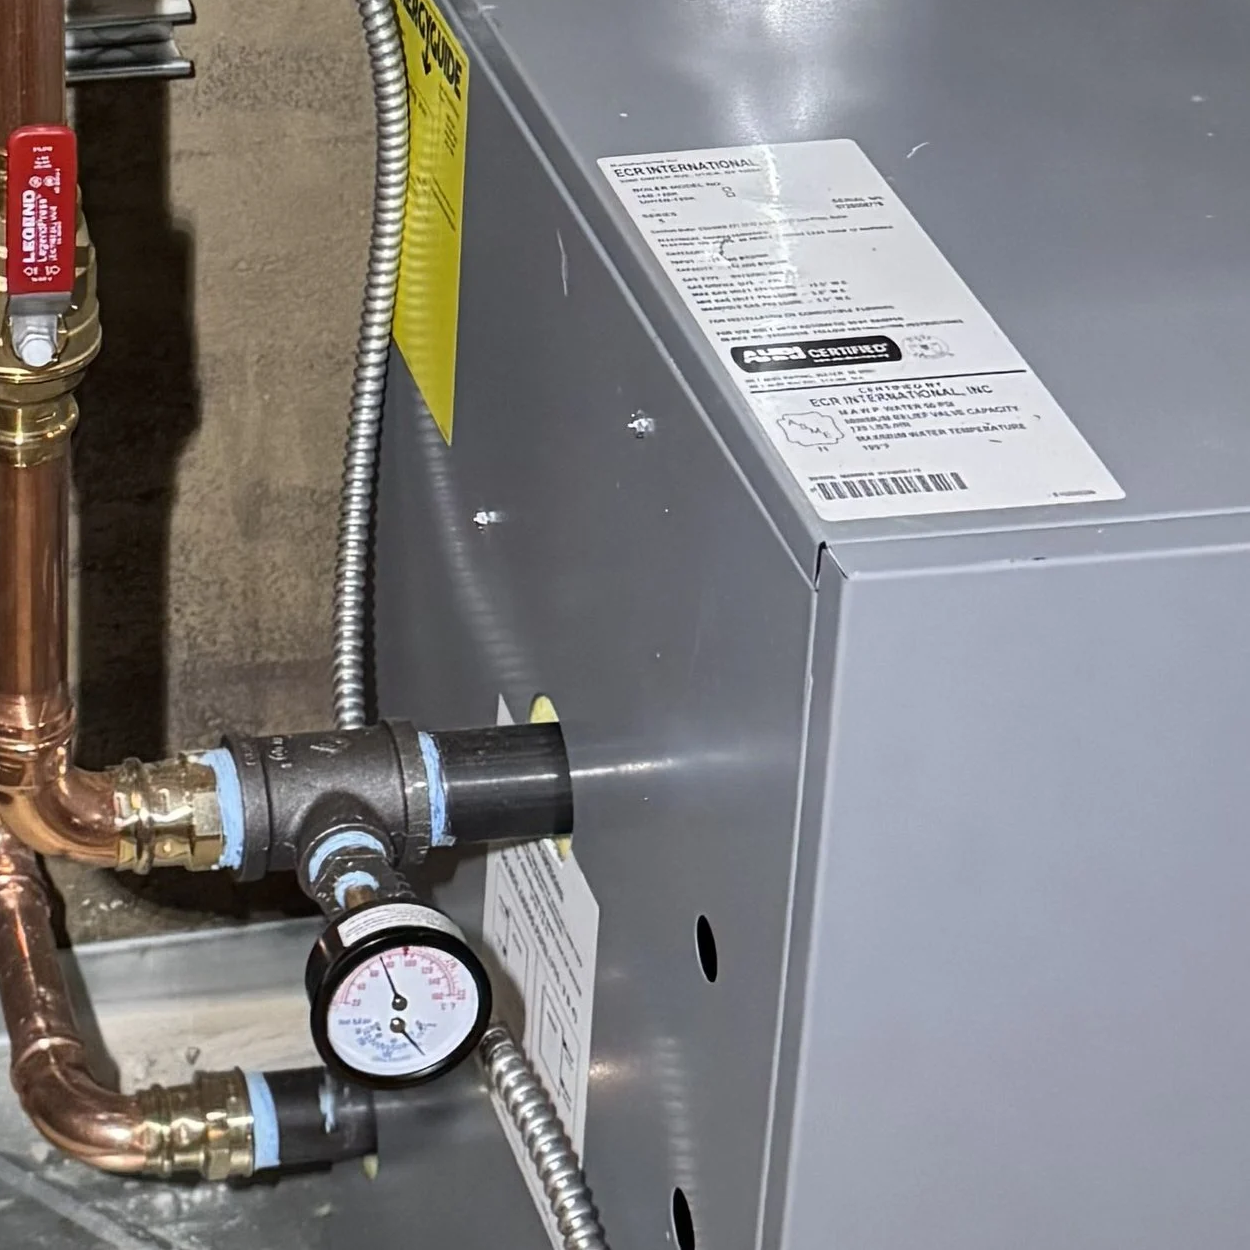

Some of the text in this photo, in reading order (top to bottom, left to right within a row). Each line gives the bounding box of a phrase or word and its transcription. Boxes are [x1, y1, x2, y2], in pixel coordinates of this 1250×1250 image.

[613, 167, 646, 178] ECR
[645, 158, 756, 175] INTERNATIONAL
[808, 396, 842, 408] ECR
[929, 409, 966, 418] VALVE
[966, 405, 1019, 415] CAPACITY
[907, 428, 948, 438] WATER
[947, 422, 1027, 435] TEMPERATURE
